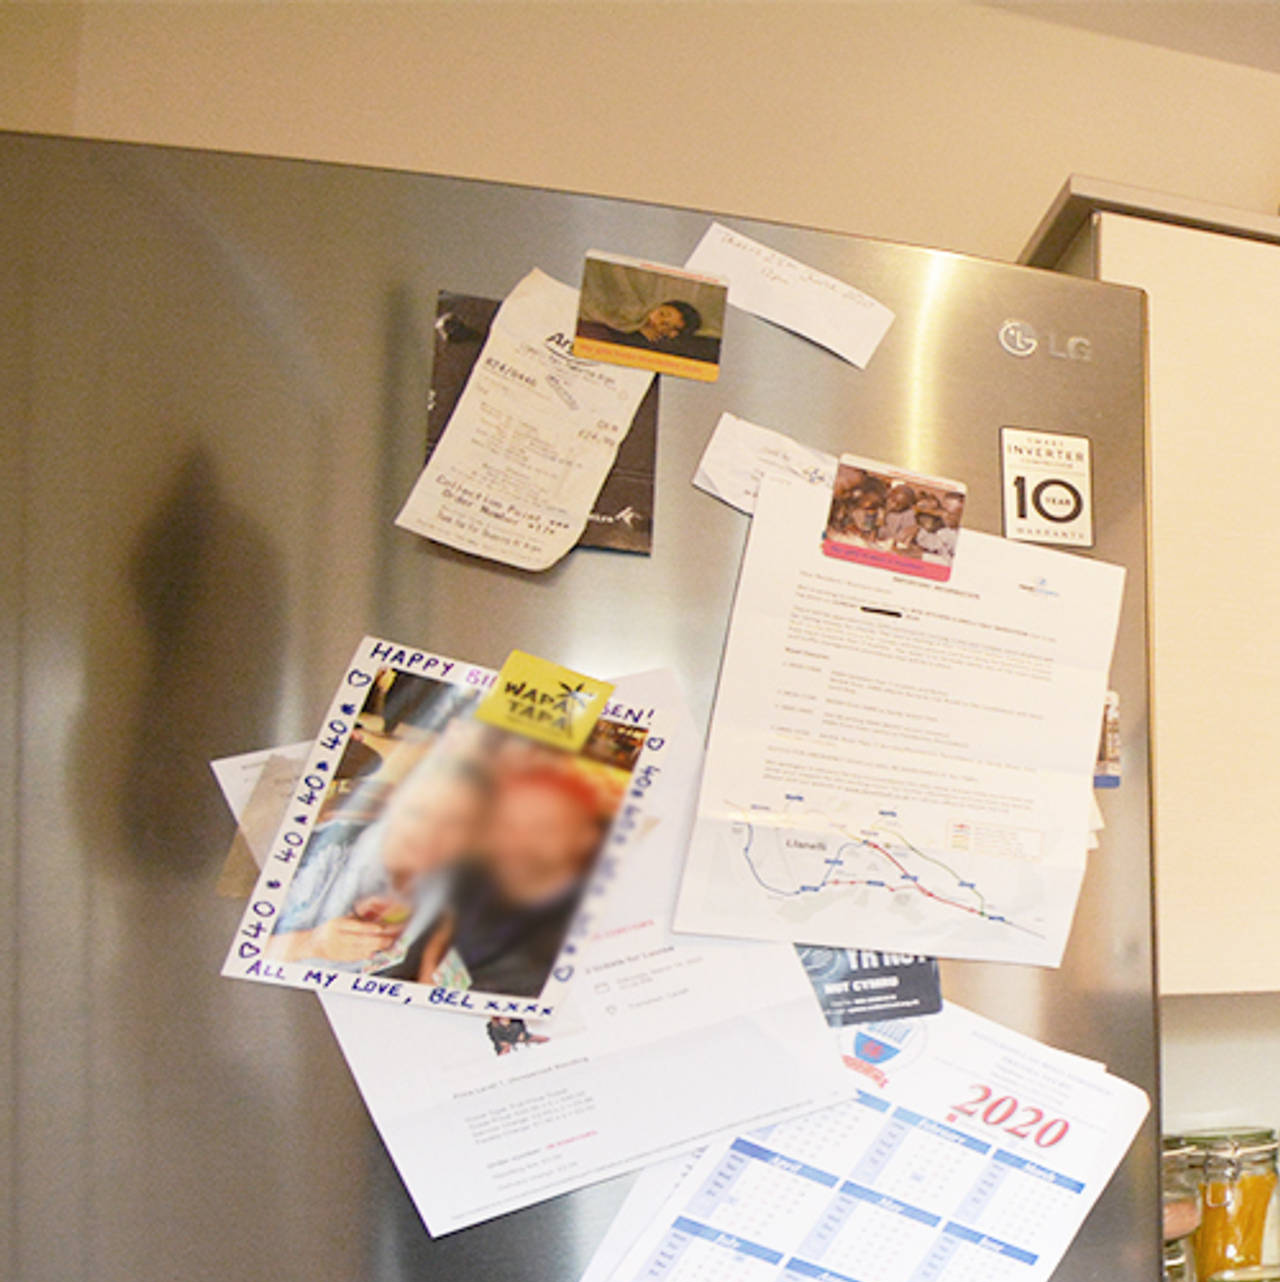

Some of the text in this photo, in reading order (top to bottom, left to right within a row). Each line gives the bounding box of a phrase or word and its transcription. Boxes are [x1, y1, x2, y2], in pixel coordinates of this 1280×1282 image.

[1049, 334, 1092, 361] LG
[1008, 444, 1084, 462] INVERTER
[1013, 475, 1083, 524] 10
[370, 642, 455, 677] HAPPY
[504, 681, 569, 713] WAPA
[508, 700, 567, 730] TAPA
[275, 830, 304, 864] 40
[241, 900, 275, 939] 40
[246, 959, 286, 980] ALL
[303, 967, 340, 989] MY
[430, 987, 474, 1010] BEL
[952, 1084, 1070, 1151] 2020
